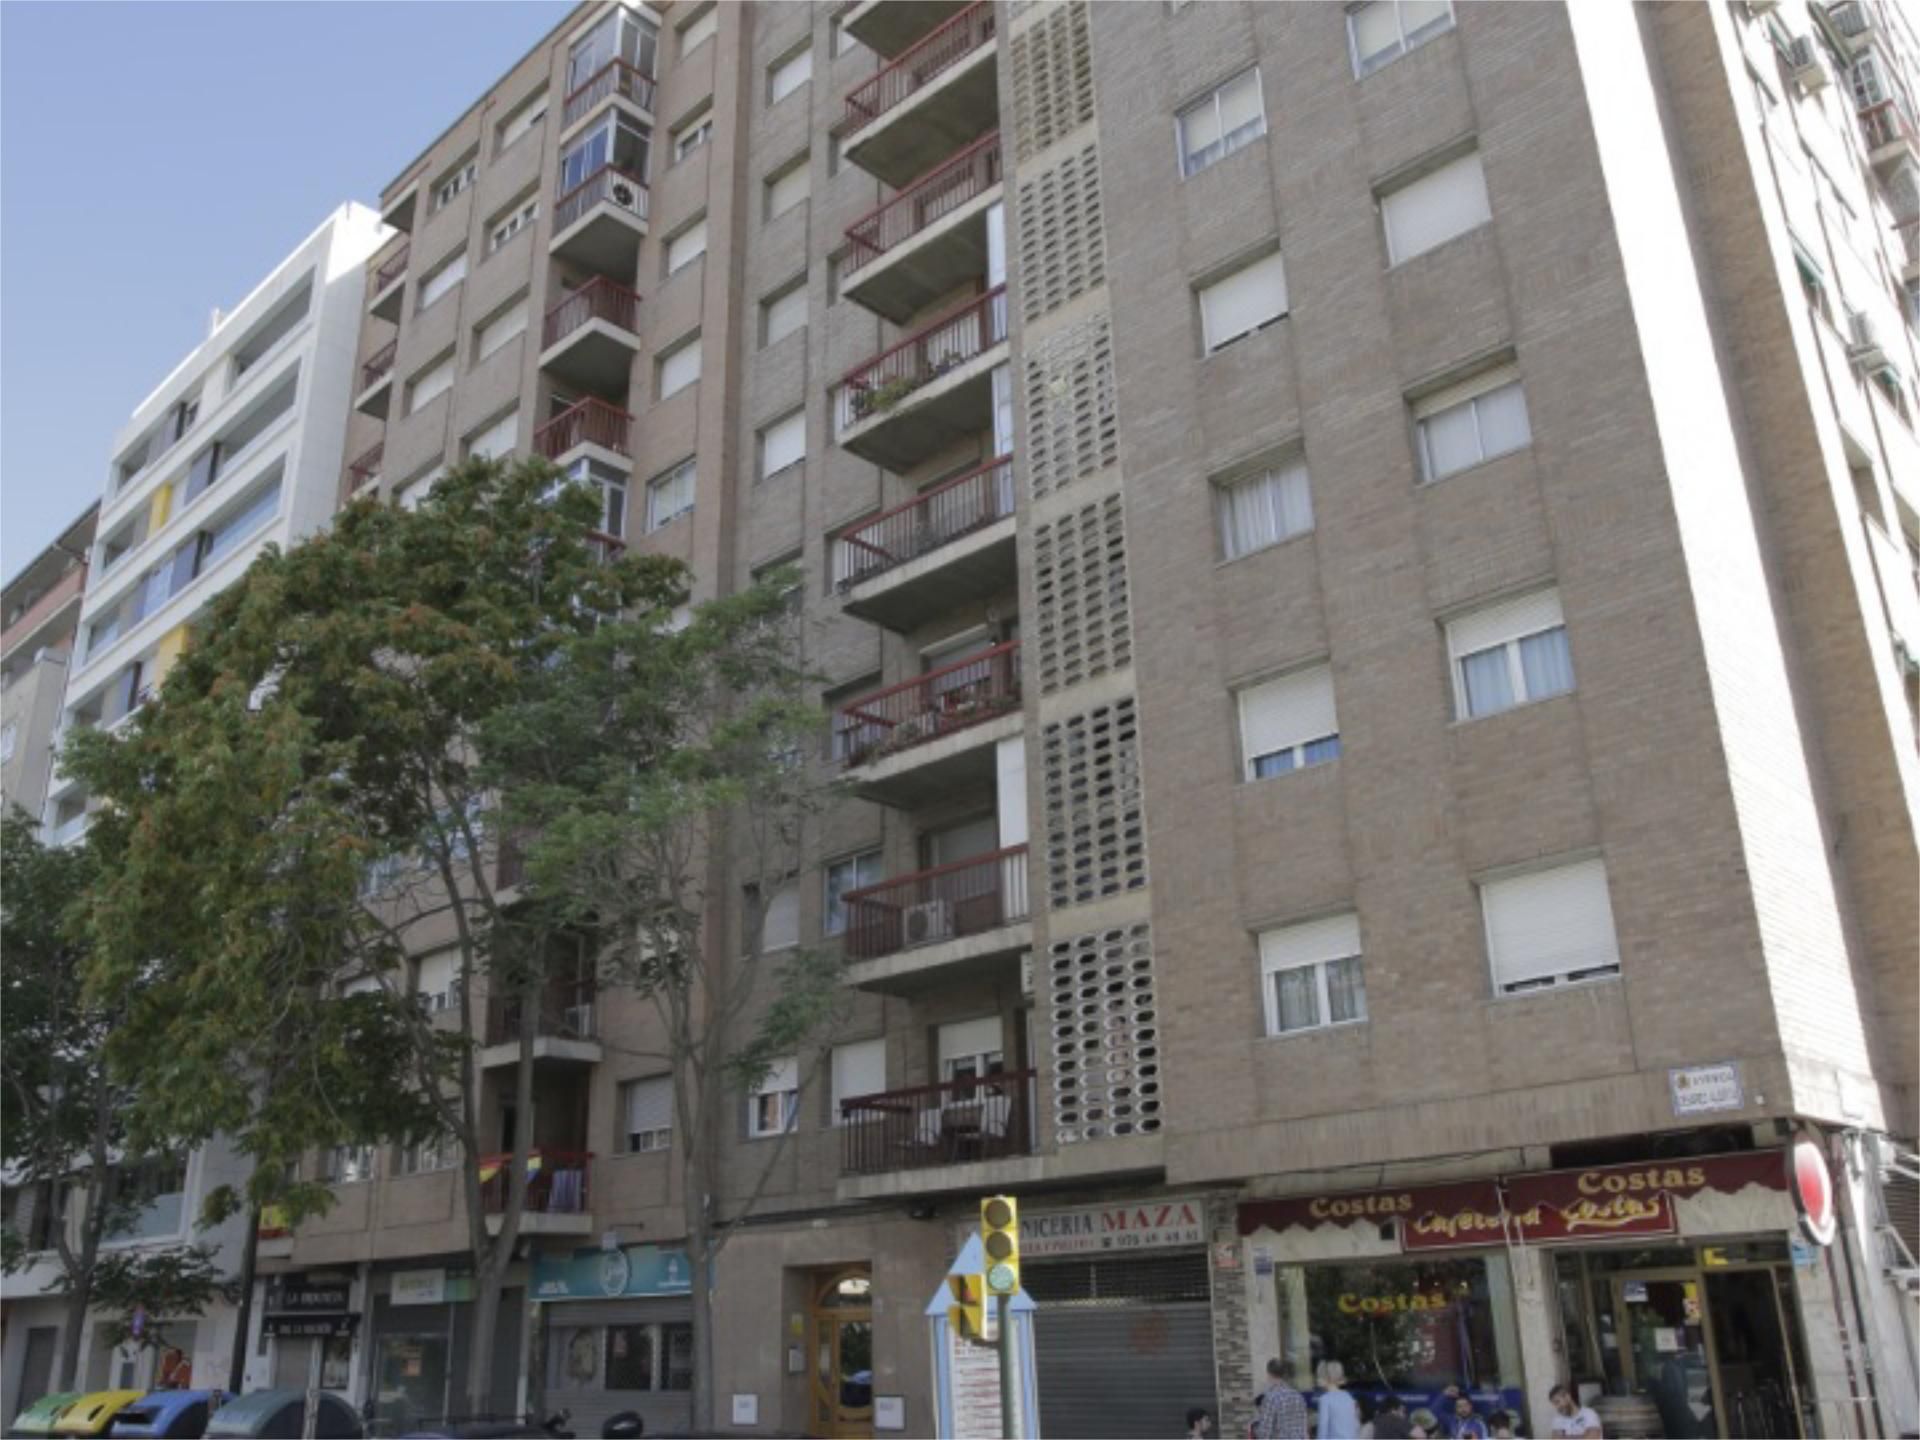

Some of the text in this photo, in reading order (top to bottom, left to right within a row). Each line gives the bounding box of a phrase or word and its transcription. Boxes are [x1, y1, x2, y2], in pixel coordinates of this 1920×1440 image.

[1577, 1165, 1707, 1195] Costas
[1101, 1202, 1198, 1232] MAZA
[1309, 1194, 1413, 1219] Costas
[1337, 1293, 1446, 1315] Costas
